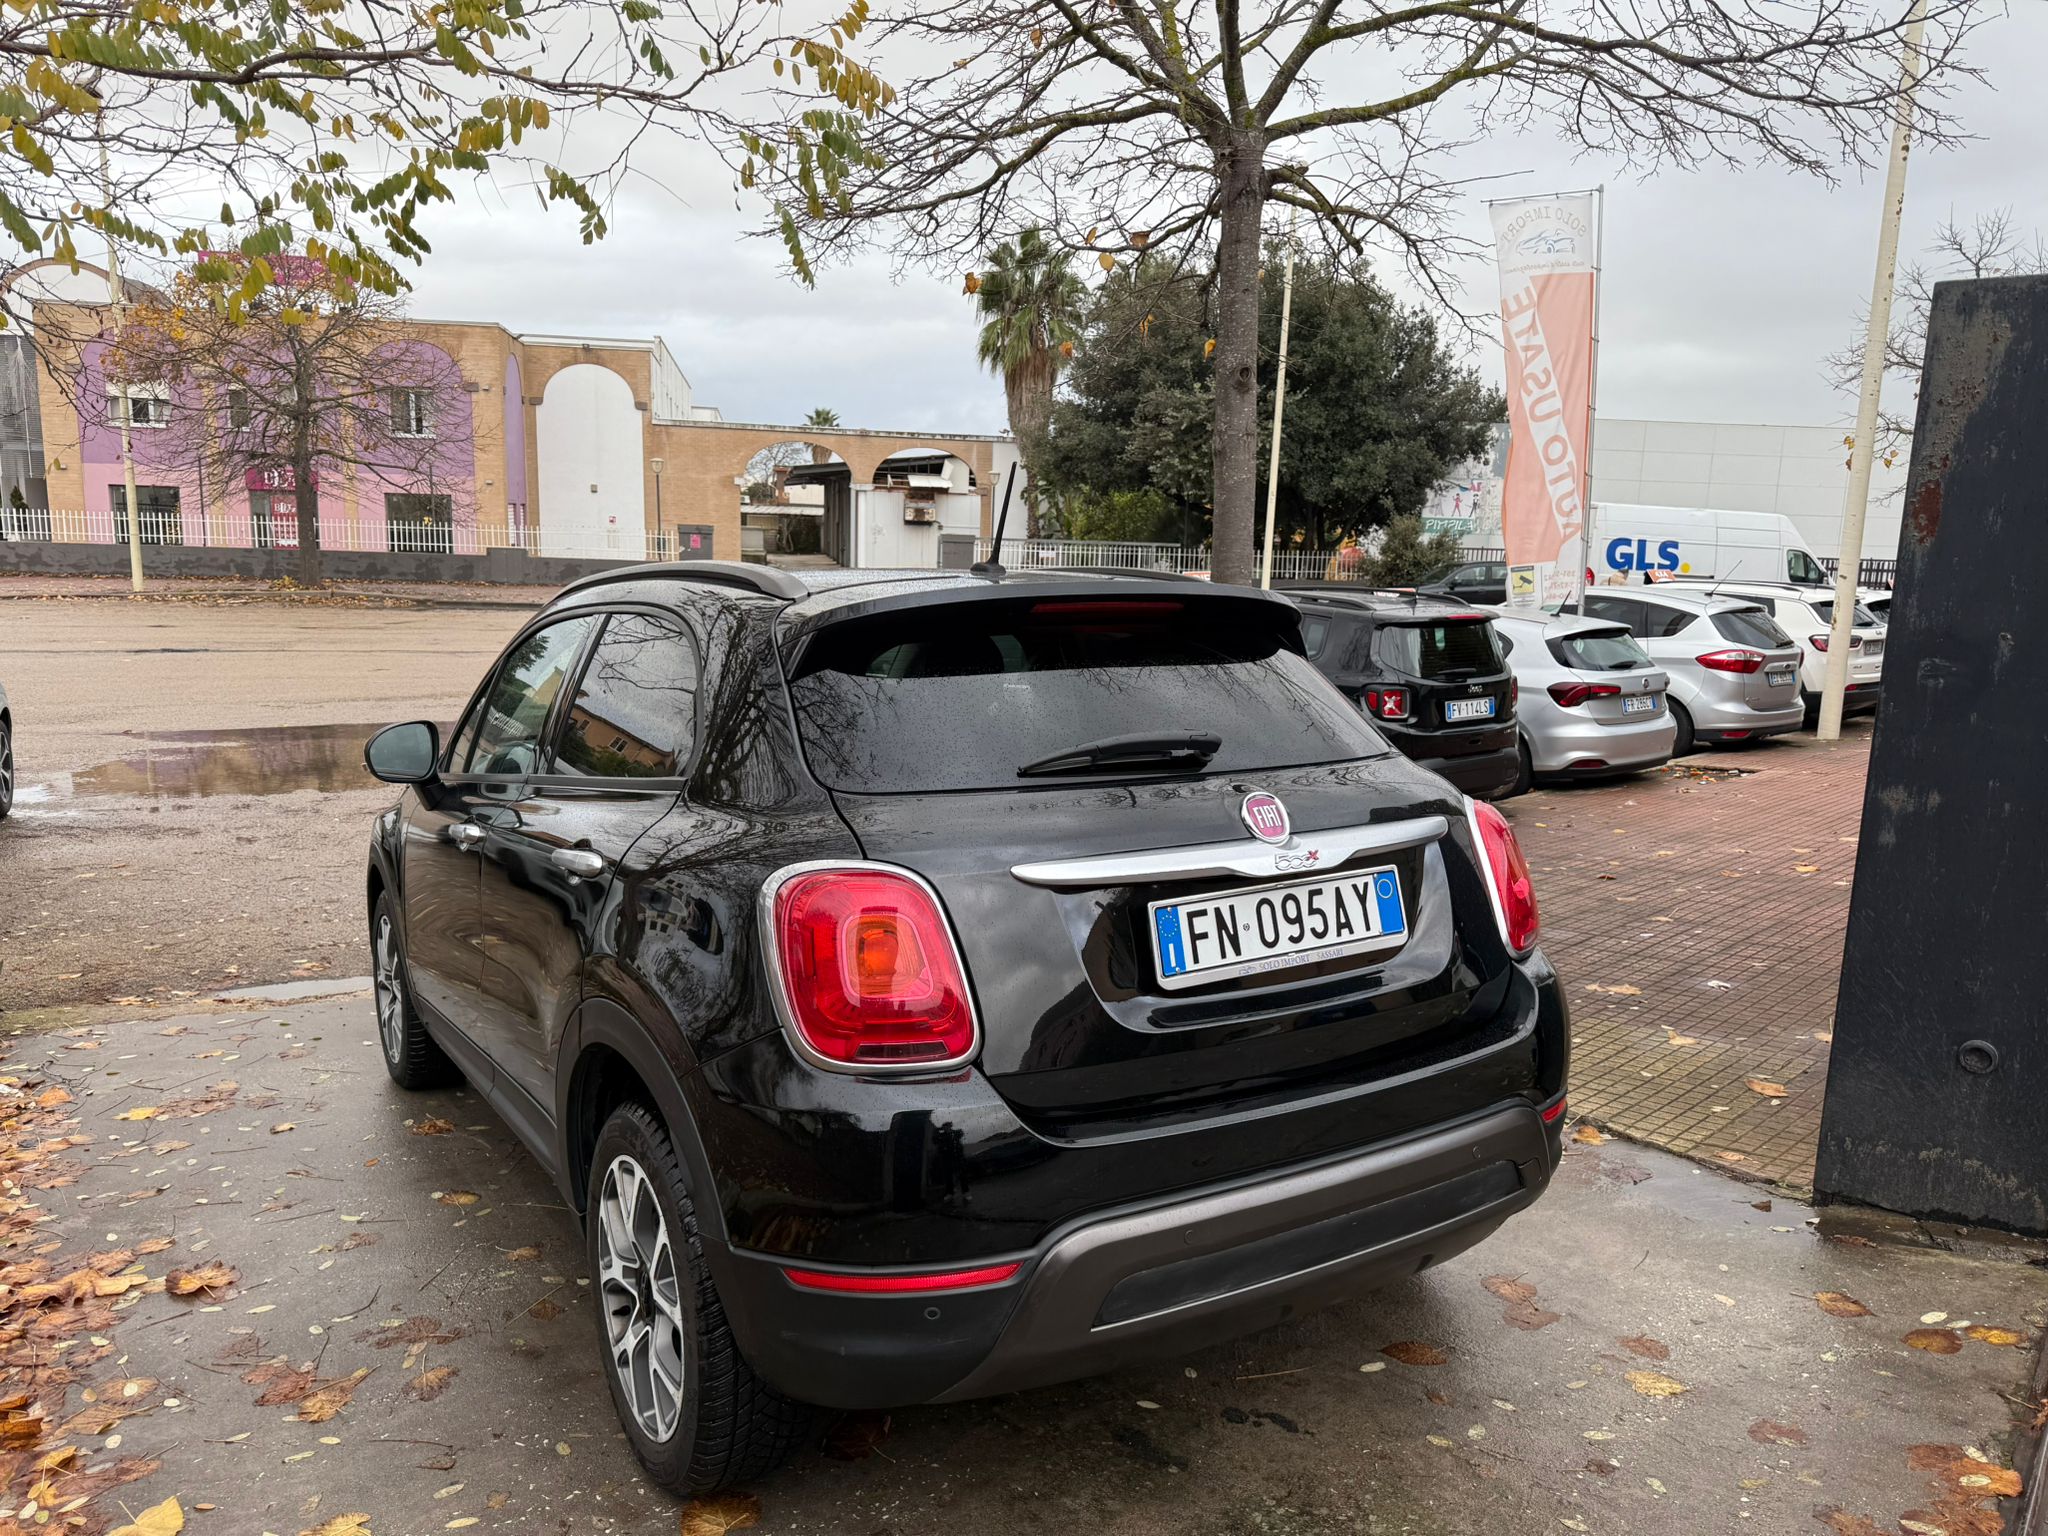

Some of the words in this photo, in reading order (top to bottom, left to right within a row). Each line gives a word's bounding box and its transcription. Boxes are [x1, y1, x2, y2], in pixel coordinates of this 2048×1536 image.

[1452, 703, 1461, 717] FV
[1465, 700, 1489, 716] 114LS
[1252, 805, 1282, 829] FIAT
[1186, 904, 1242, 964] FN
[1255, 881, 1369, 949] 095AY
[1260, 958, 1280, 971] SOLO
[1281, 953, 1311, 968] IMPORT
[1317, 948, 1344, 961] SASSARI
